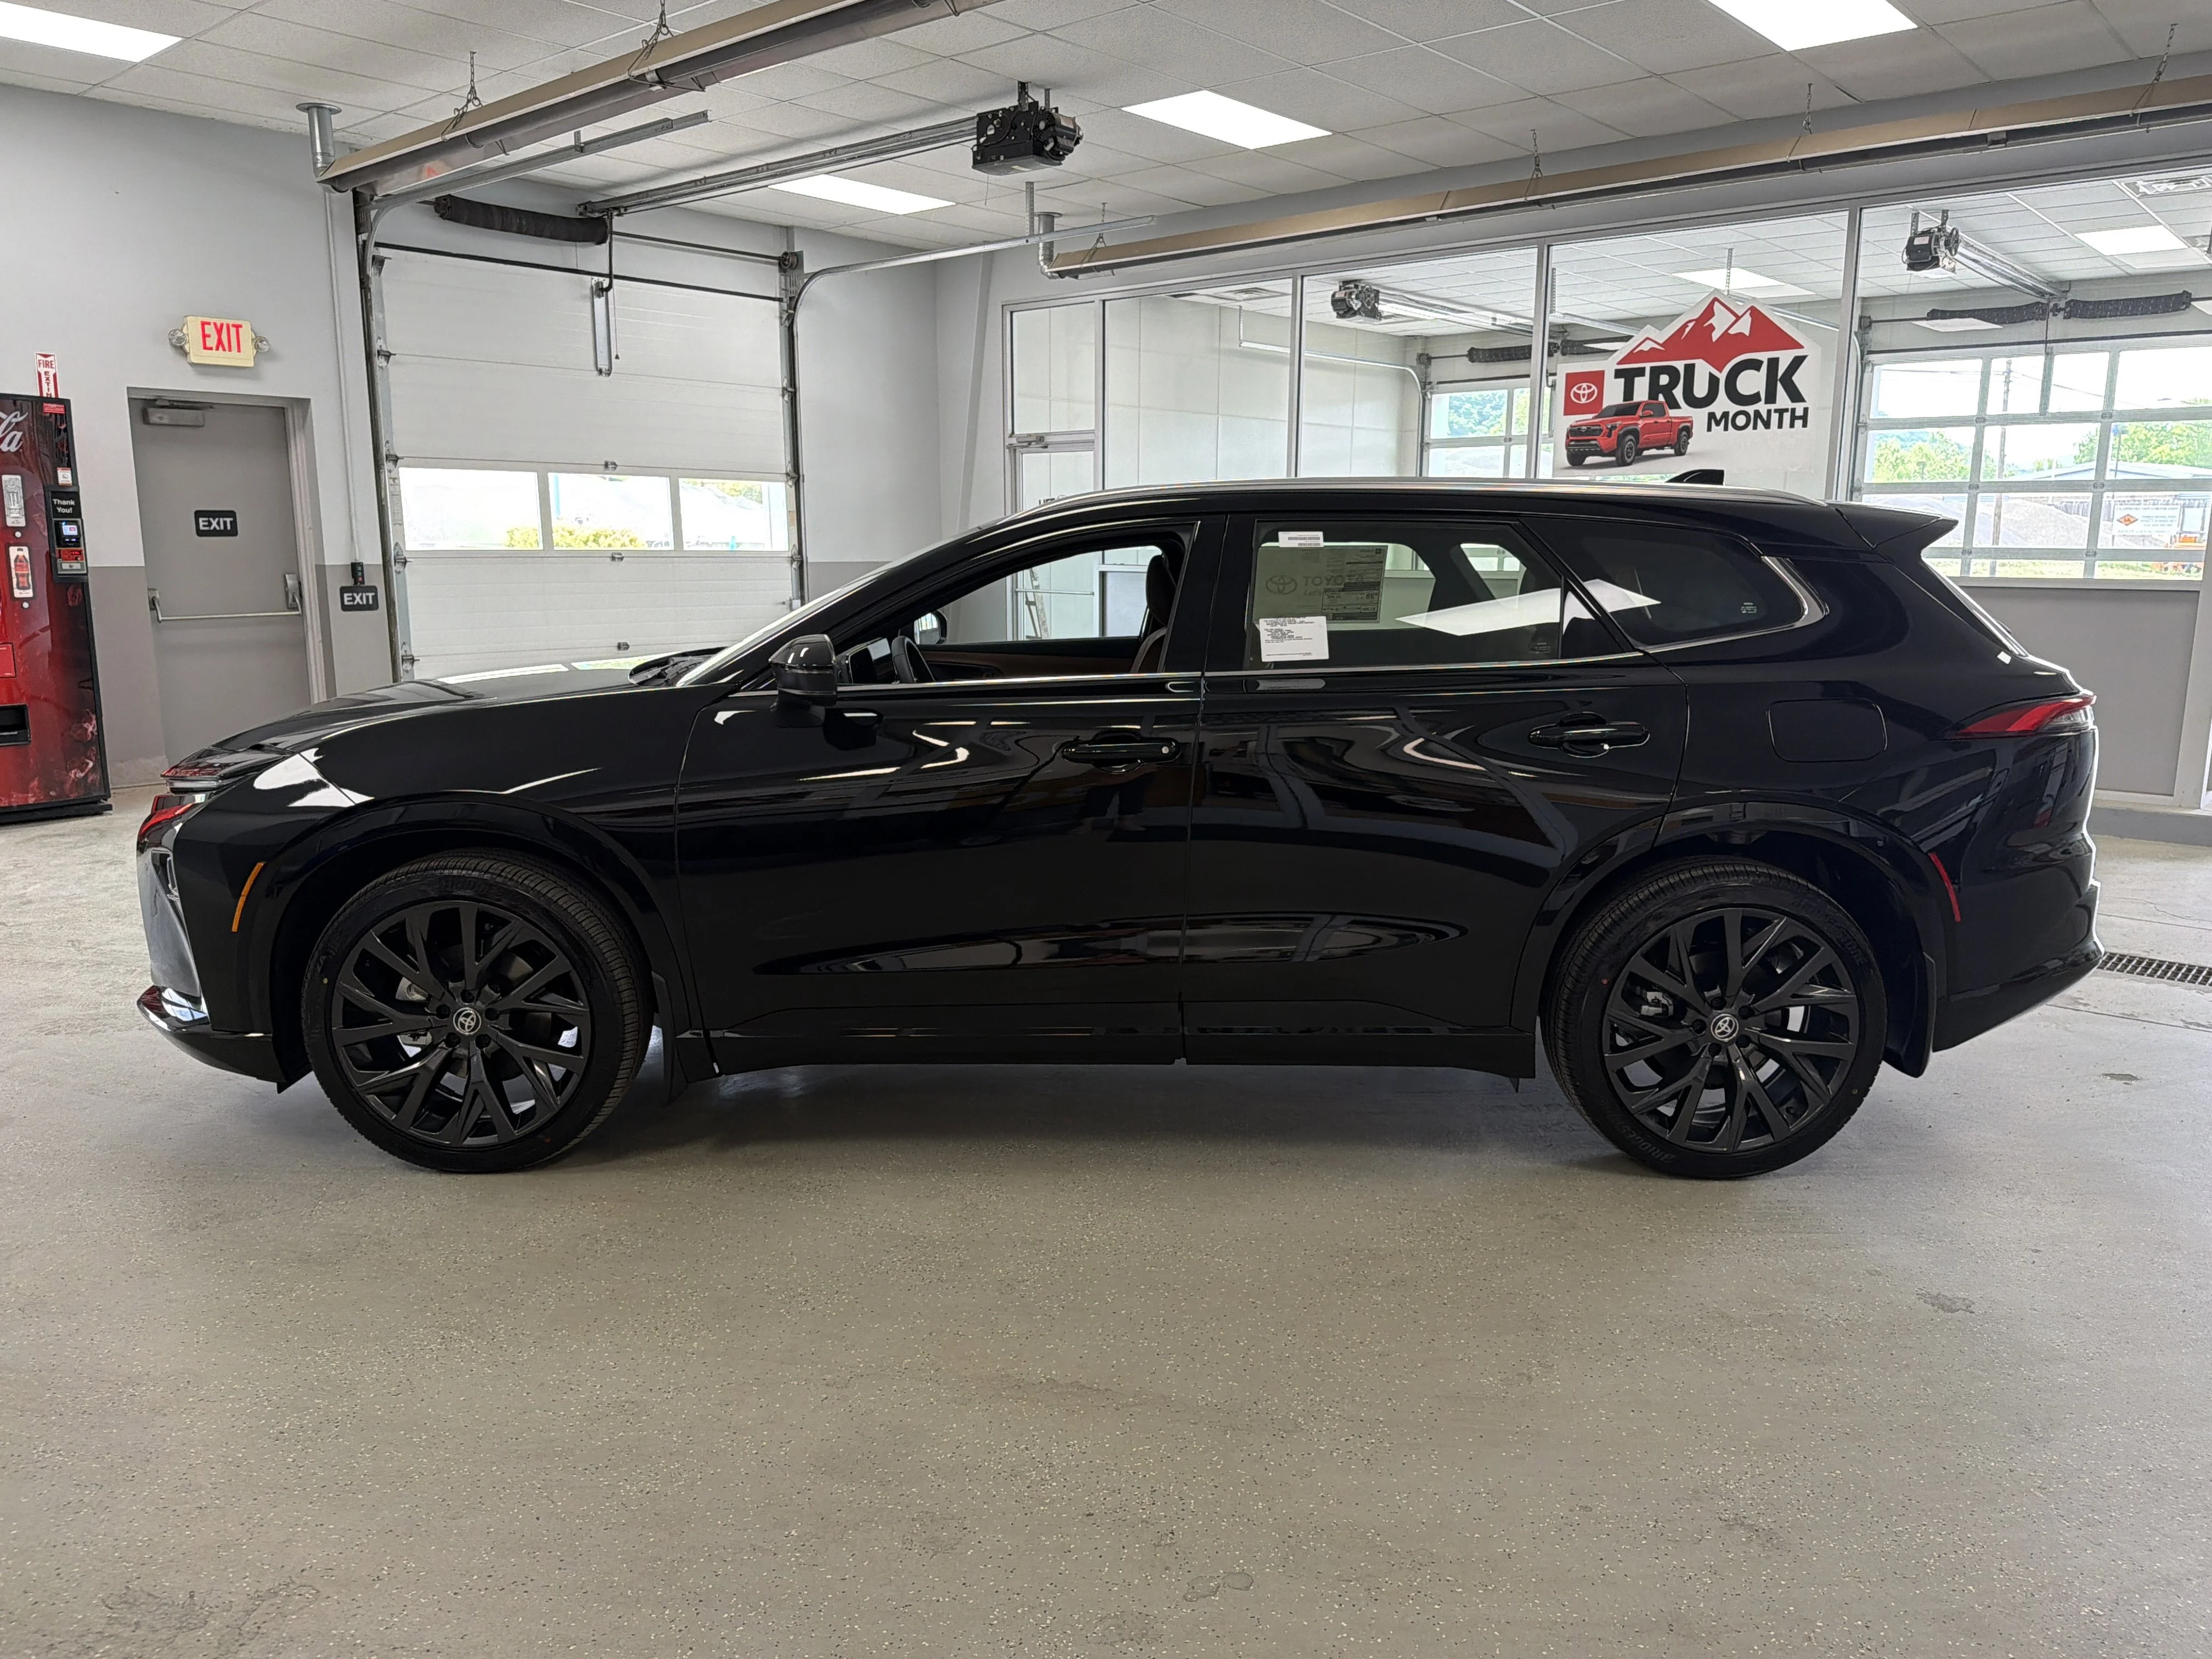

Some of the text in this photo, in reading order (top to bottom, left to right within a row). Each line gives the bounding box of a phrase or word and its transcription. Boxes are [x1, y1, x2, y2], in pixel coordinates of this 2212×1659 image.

[200, 321, 243, 353] EXIT
[38, 359, 55, 369] FIRE
[1613, 355, 1809, 409] TRUCK
[1707, 407, 1809, 432] MONTH
[199, 517, 233, 531] EXIT
[1302, 574, 1359, 586] TOYO
[343, 592, 375, 605] EXIT
